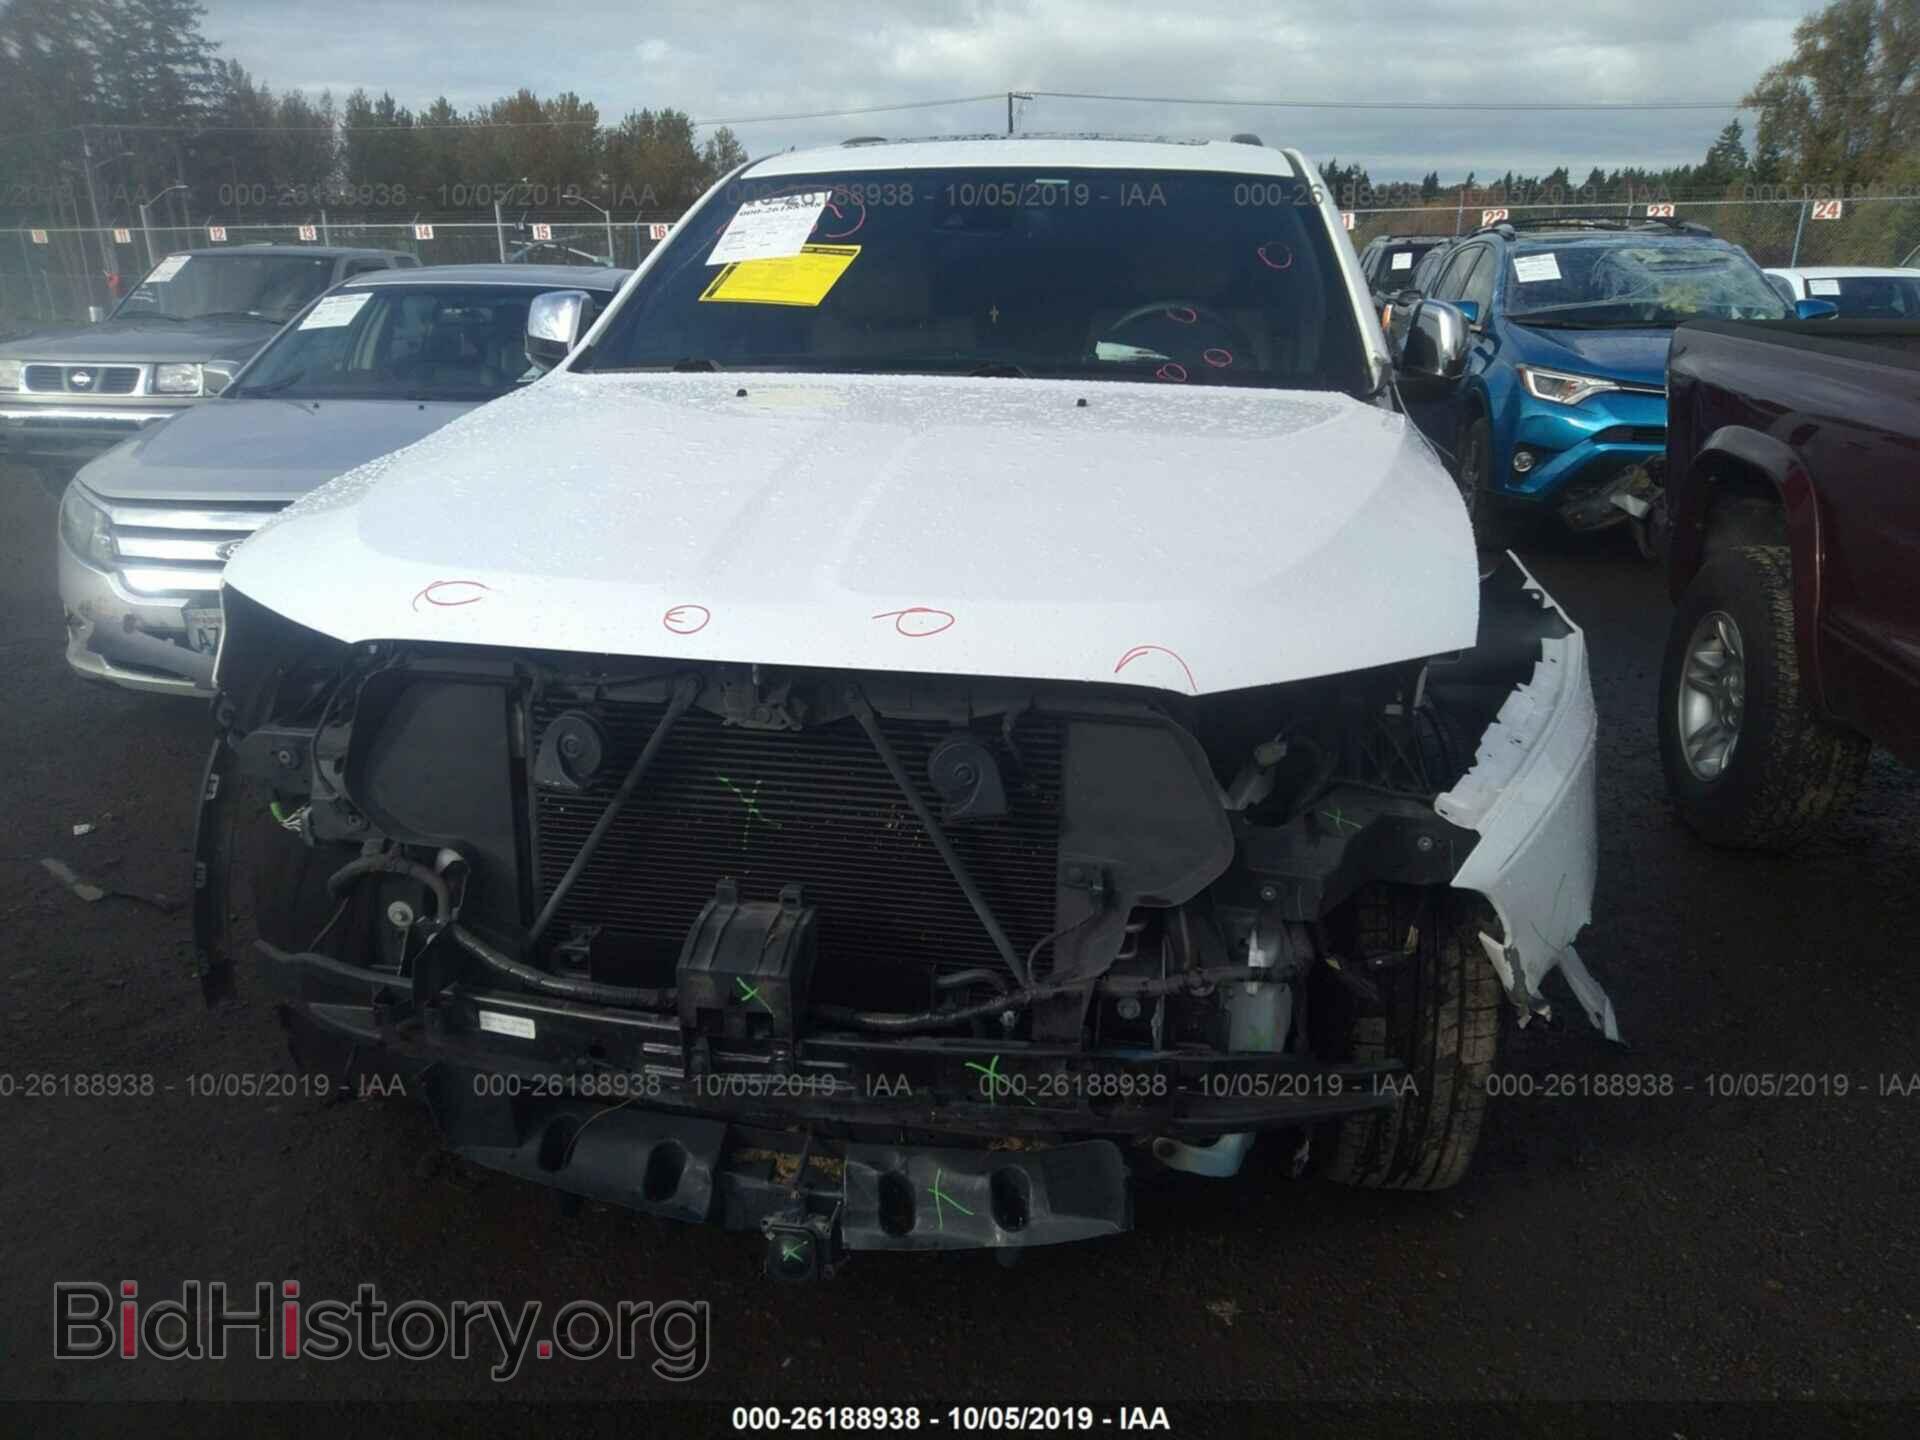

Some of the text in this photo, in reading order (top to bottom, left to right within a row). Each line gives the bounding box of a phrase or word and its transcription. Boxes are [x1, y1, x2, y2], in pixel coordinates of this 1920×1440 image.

[1815, 201, 1839, 218] 24
[419, 226, 430, 238] 14
[536, 225, 549, 239] 15
[654, 224, 666, 238] 16
